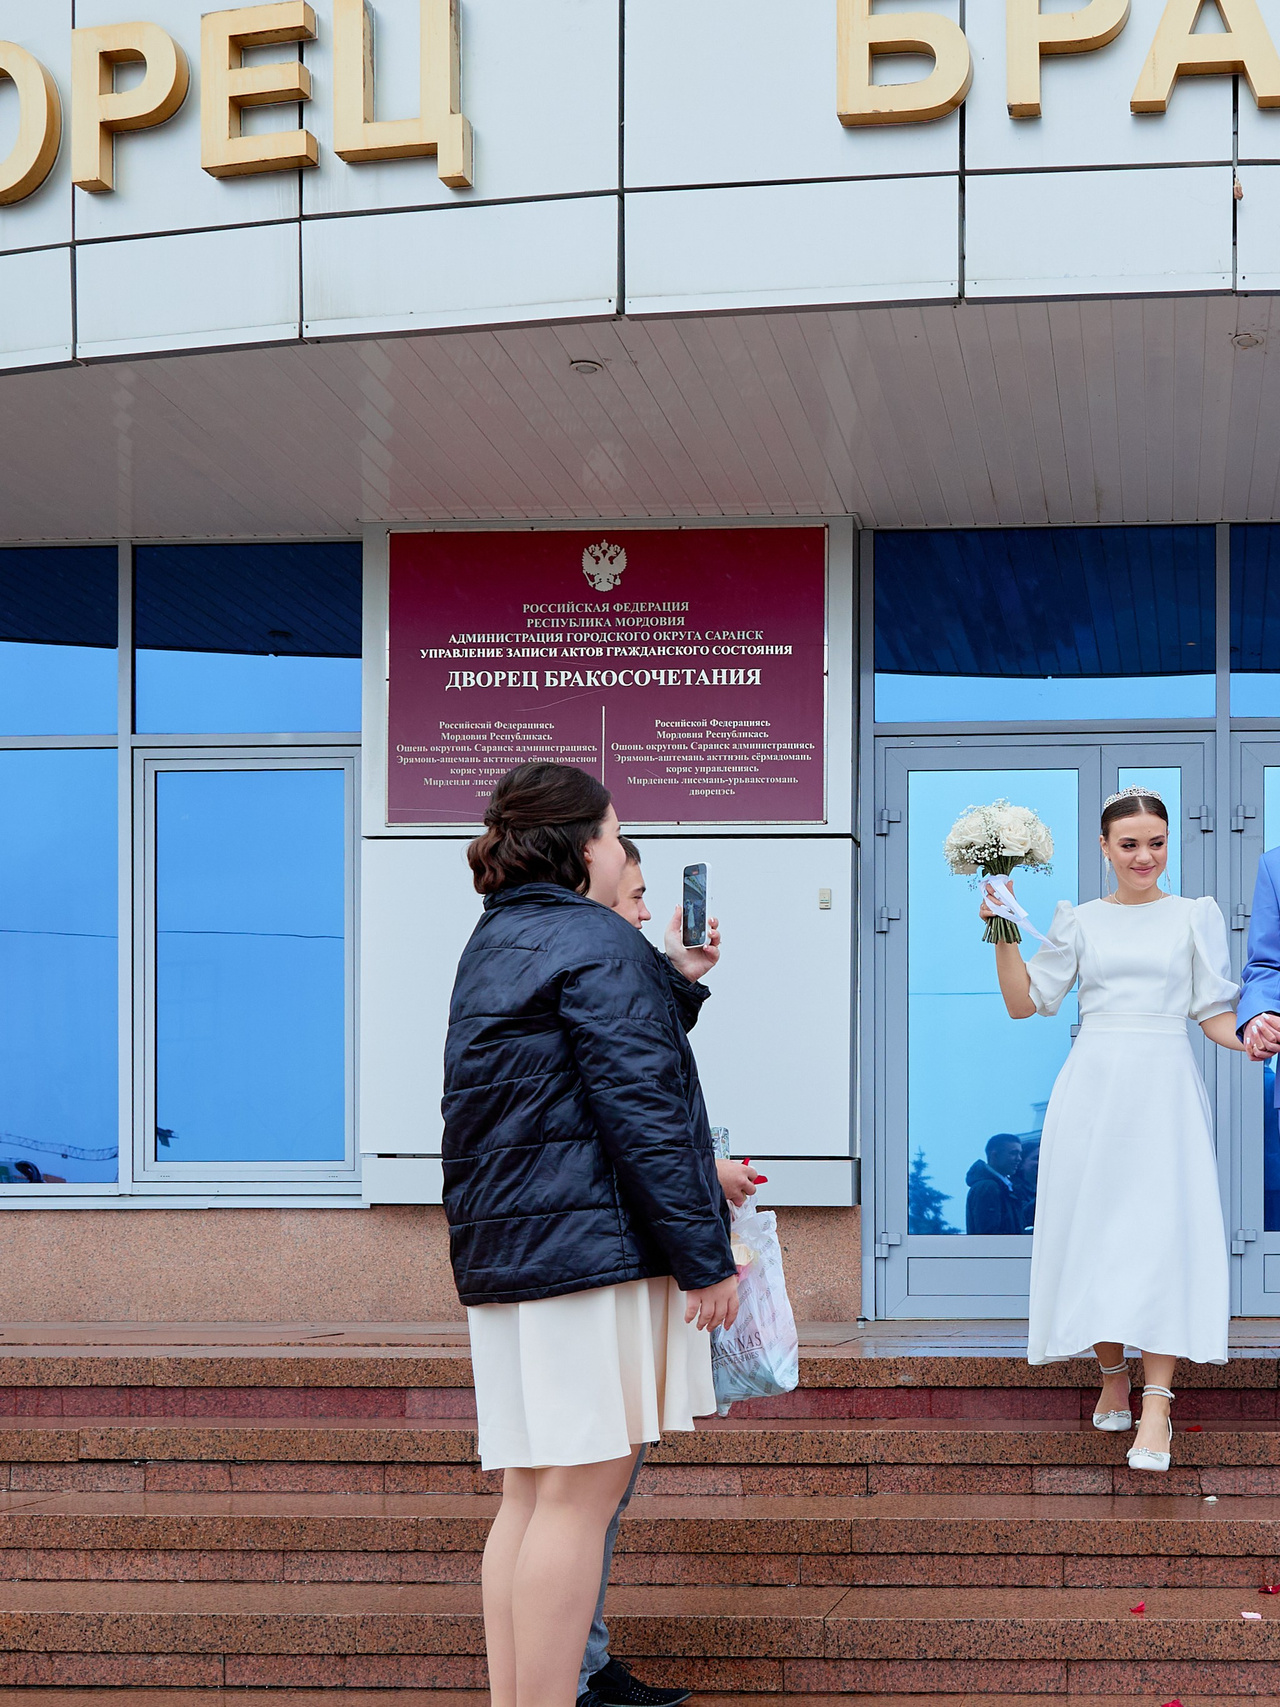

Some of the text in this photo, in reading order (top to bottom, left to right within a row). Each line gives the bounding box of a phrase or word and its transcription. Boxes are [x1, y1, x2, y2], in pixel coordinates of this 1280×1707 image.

[523, 602, 689, 613] РОССИЙСКАЯ ФЕДЕРАЦИЯ
[526, 617, 685, 627] РЕСПУБЛИКА МОРДОВИЯ
[448, 631, 764, 644] АДМИНИСТРАЦИЯ ГОРОДСКОГО ОКРУГА САРАНСК
[419, 646, 793, 658] УПРАВЛЕНИЕ ЗАПИСИ АКТОВ ГРАЖДАНСКОГО СОСТОЯНИЯ
[446, 669, 761, 691] ДВОРЕЦ БРАКОСОЧЕТАНИЯ
[493, 721, 555, 731] Федерациясь
[655, 718, 771, 728] Российской Федерациясь
[441, 733, 553, 742] Мордовия Республикась
[656, 730, 769, 740] Мордовия Республикась
[429, 745, 472, 754] округонь
[474, 744, 514, 753] Саранск
[515, 745, 598, 754] администрациясь
[645, 743, 689, 753] округонь
[690, 742, 731, 751] Саранск
[732, 742, 815, 752] администрациясь
[751, 753, 812, 762] сёрмадомань
[450, 768, 477, 777] коряс
[665, 765, 760, 775] коряс управлениясь
